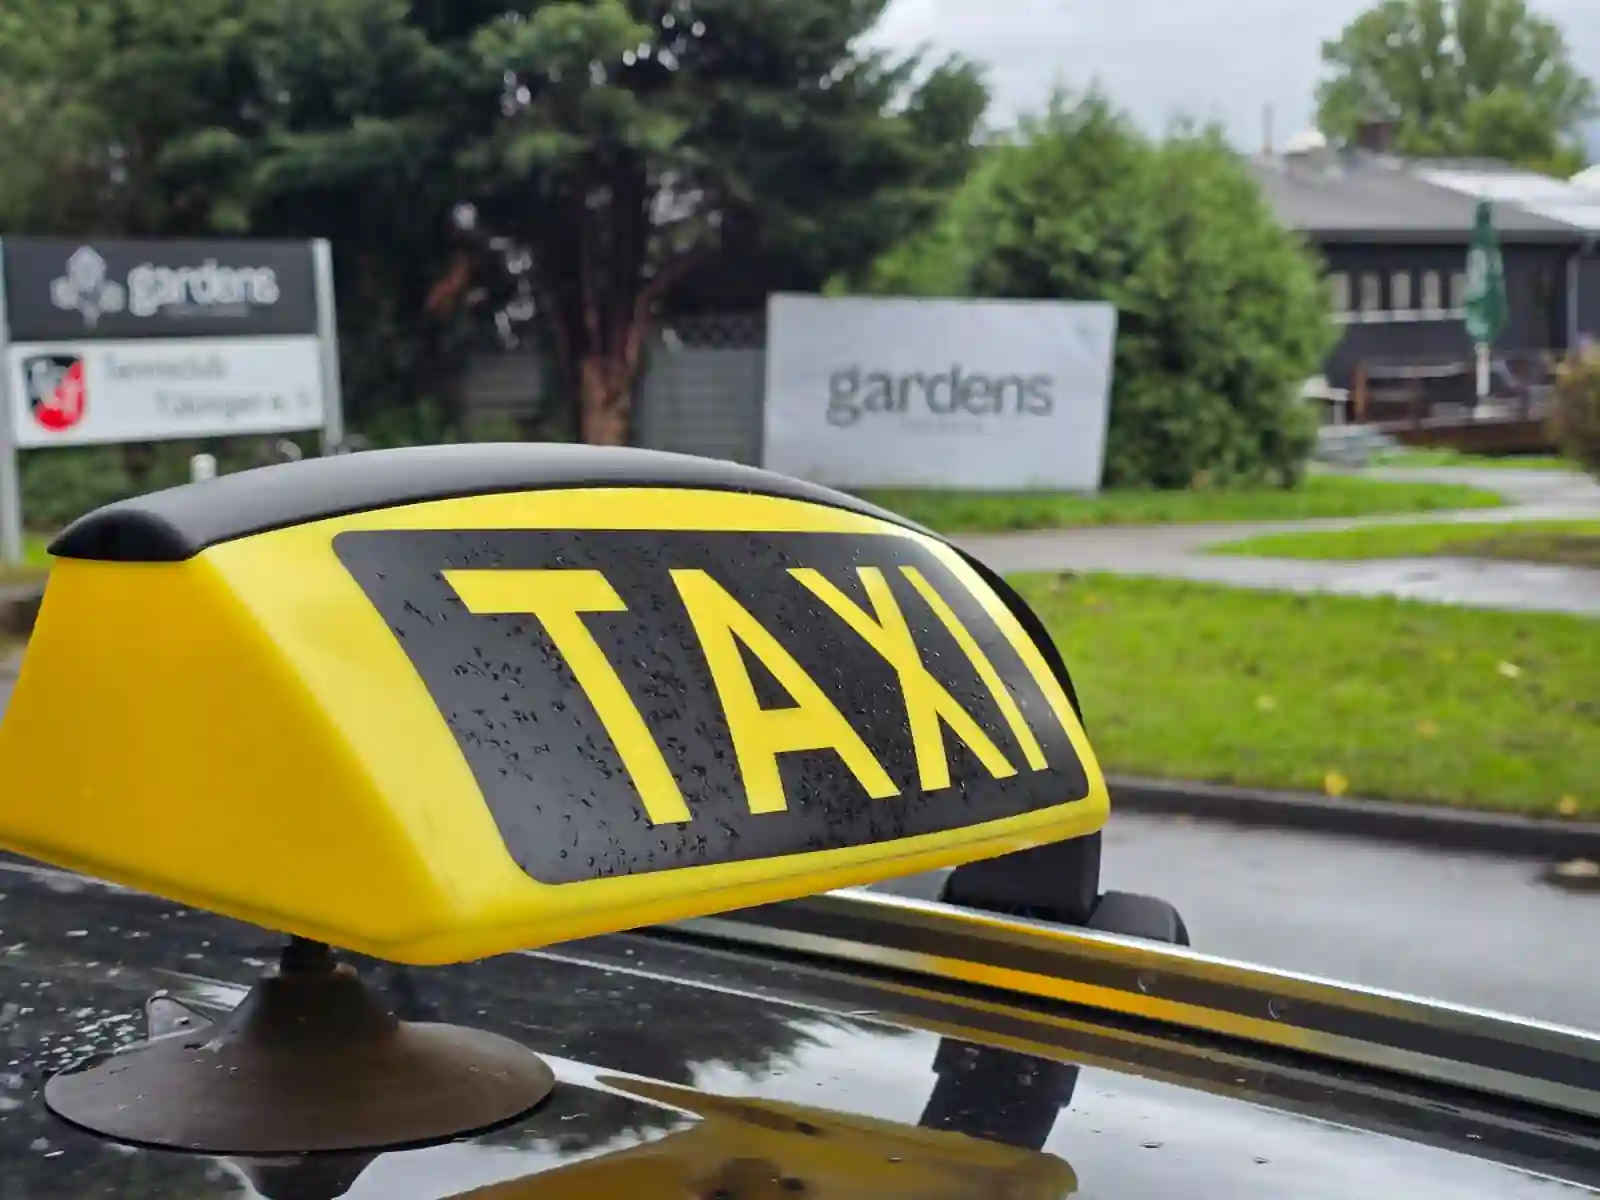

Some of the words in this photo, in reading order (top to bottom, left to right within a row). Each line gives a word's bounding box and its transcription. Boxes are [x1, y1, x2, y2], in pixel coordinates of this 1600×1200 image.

[128, 260, 280, 317] gardens
[825, 364, 1054, 428] gardens
[440, 566, 1048, 825] TAXI
